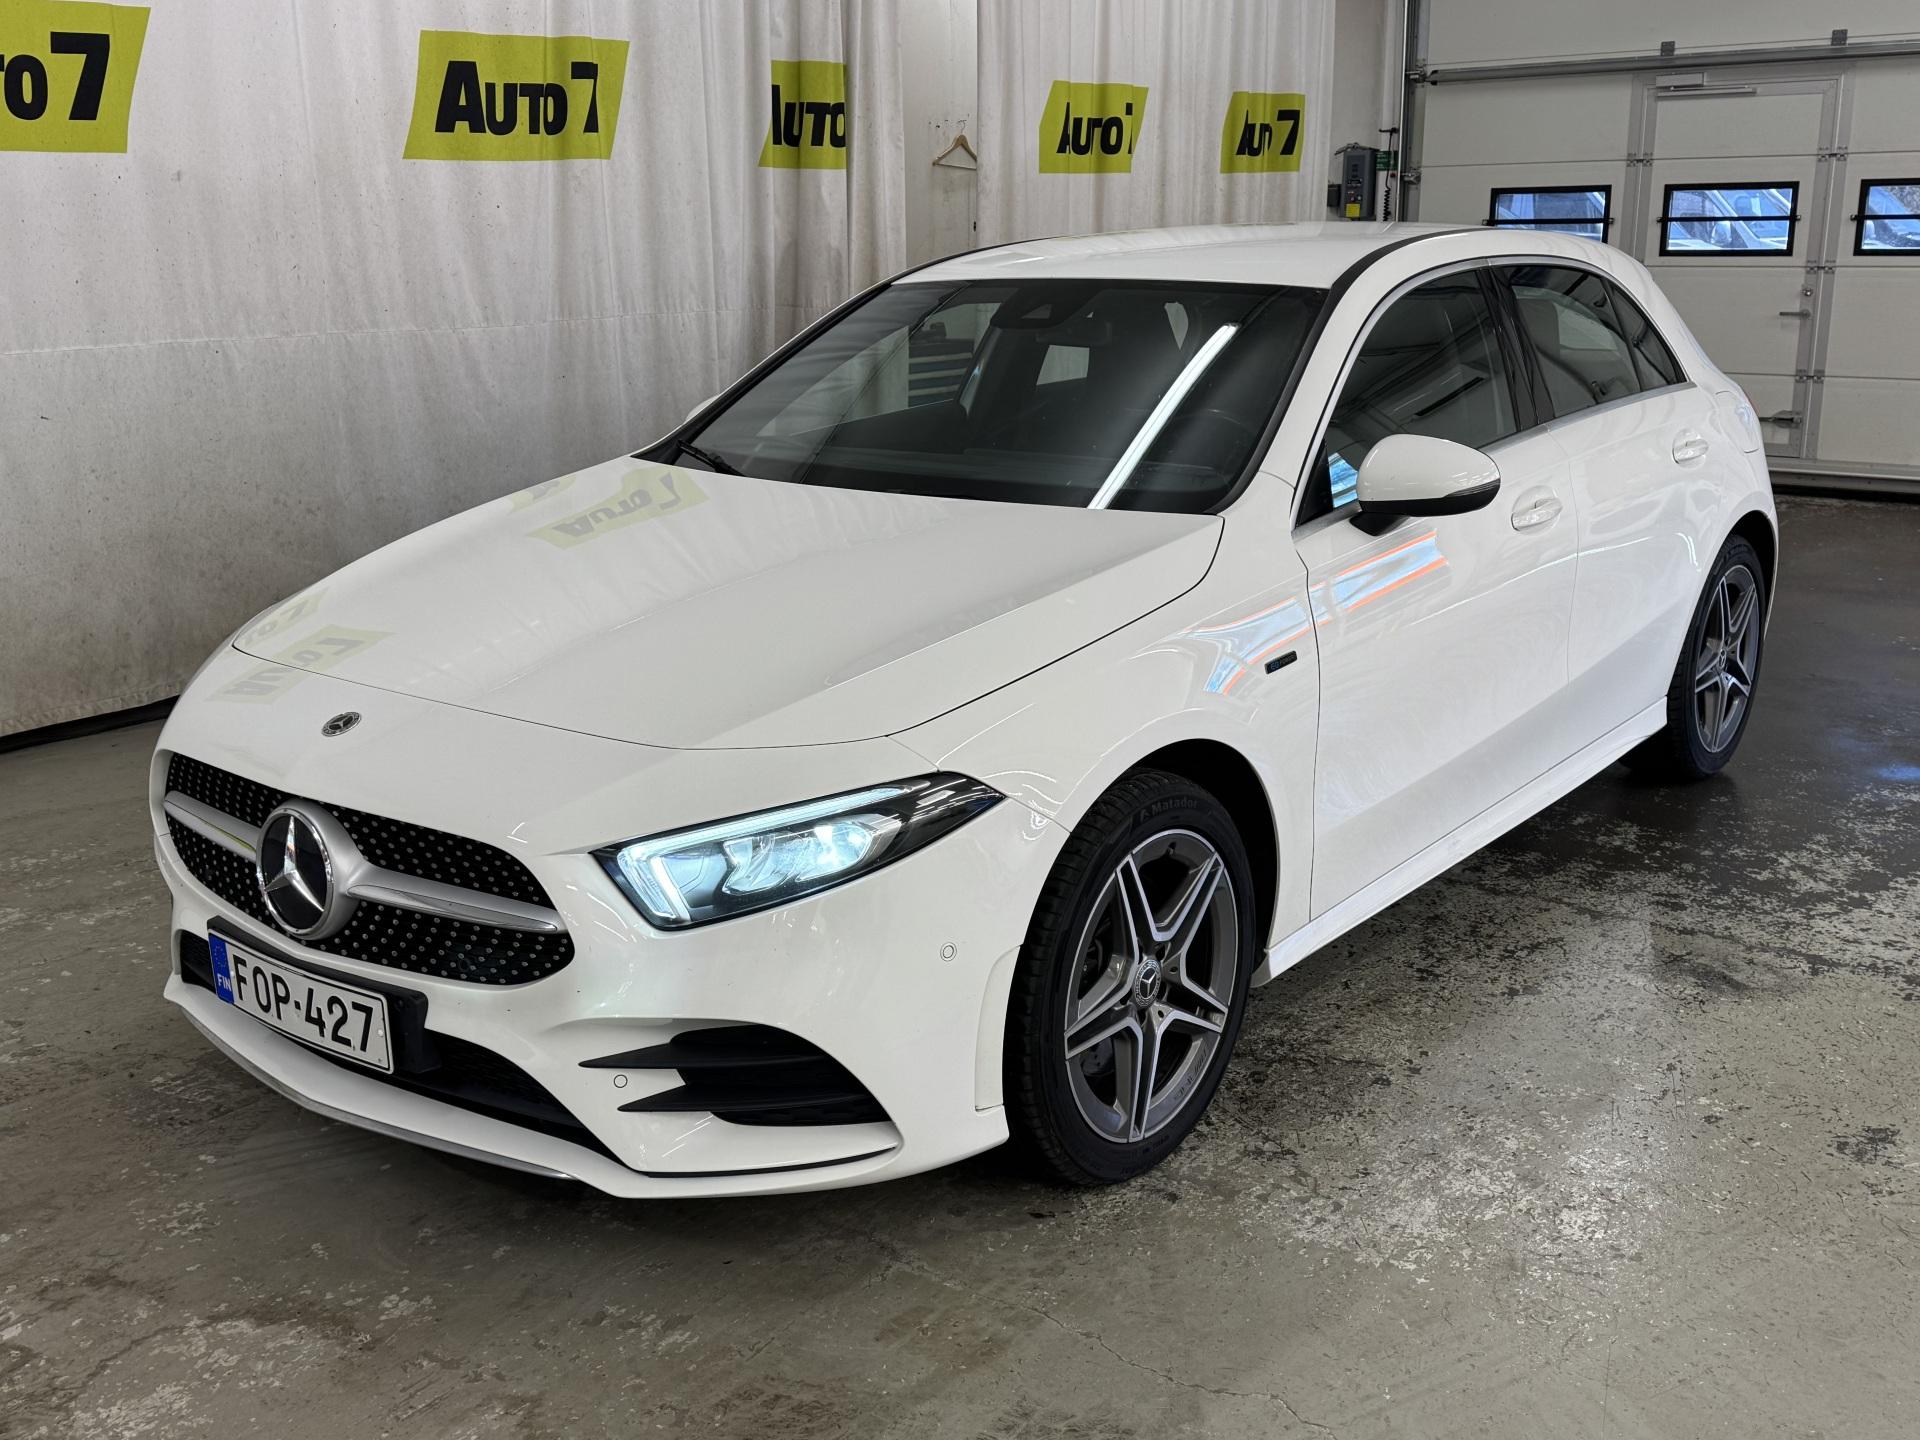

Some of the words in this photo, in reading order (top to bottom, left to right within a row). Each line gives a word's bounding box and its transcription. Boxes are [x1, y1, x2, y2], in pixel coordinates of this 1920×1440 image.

[0, 54, 48, 120] O
[50, 31, 110, 120] 7
[571, 61, 599, 133] 7
[1277, 109, 1300, 155] 7
[217, 973, 232, 991] FIN
[233, 954, 373, 1052] FOP-427
